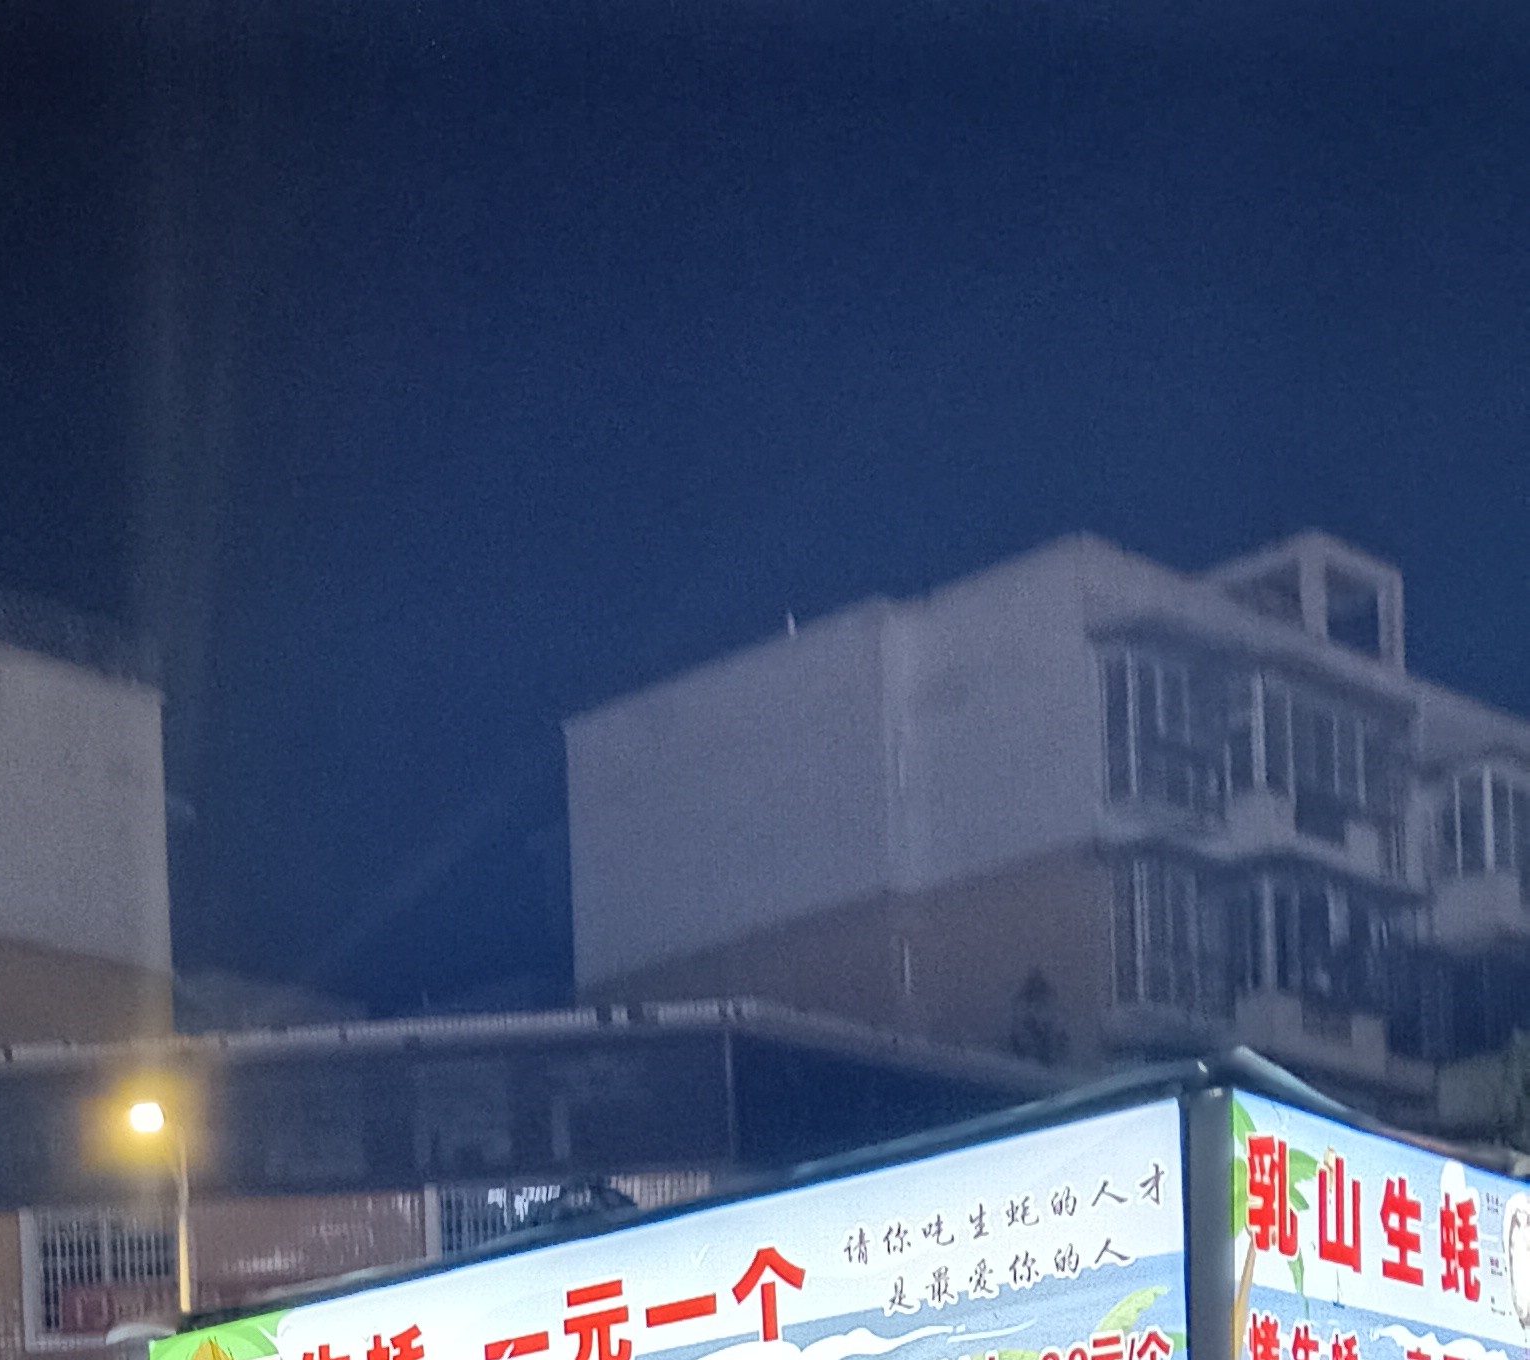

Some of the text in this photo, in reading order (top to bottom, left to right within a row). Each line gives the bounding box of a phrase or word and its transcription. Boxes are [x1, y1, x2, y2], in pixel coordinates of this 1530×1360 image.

[889, 1238, 1131, 1311] 是最爱你的人
[1248, 1135, 1481, 1303] 乳山生蚝
